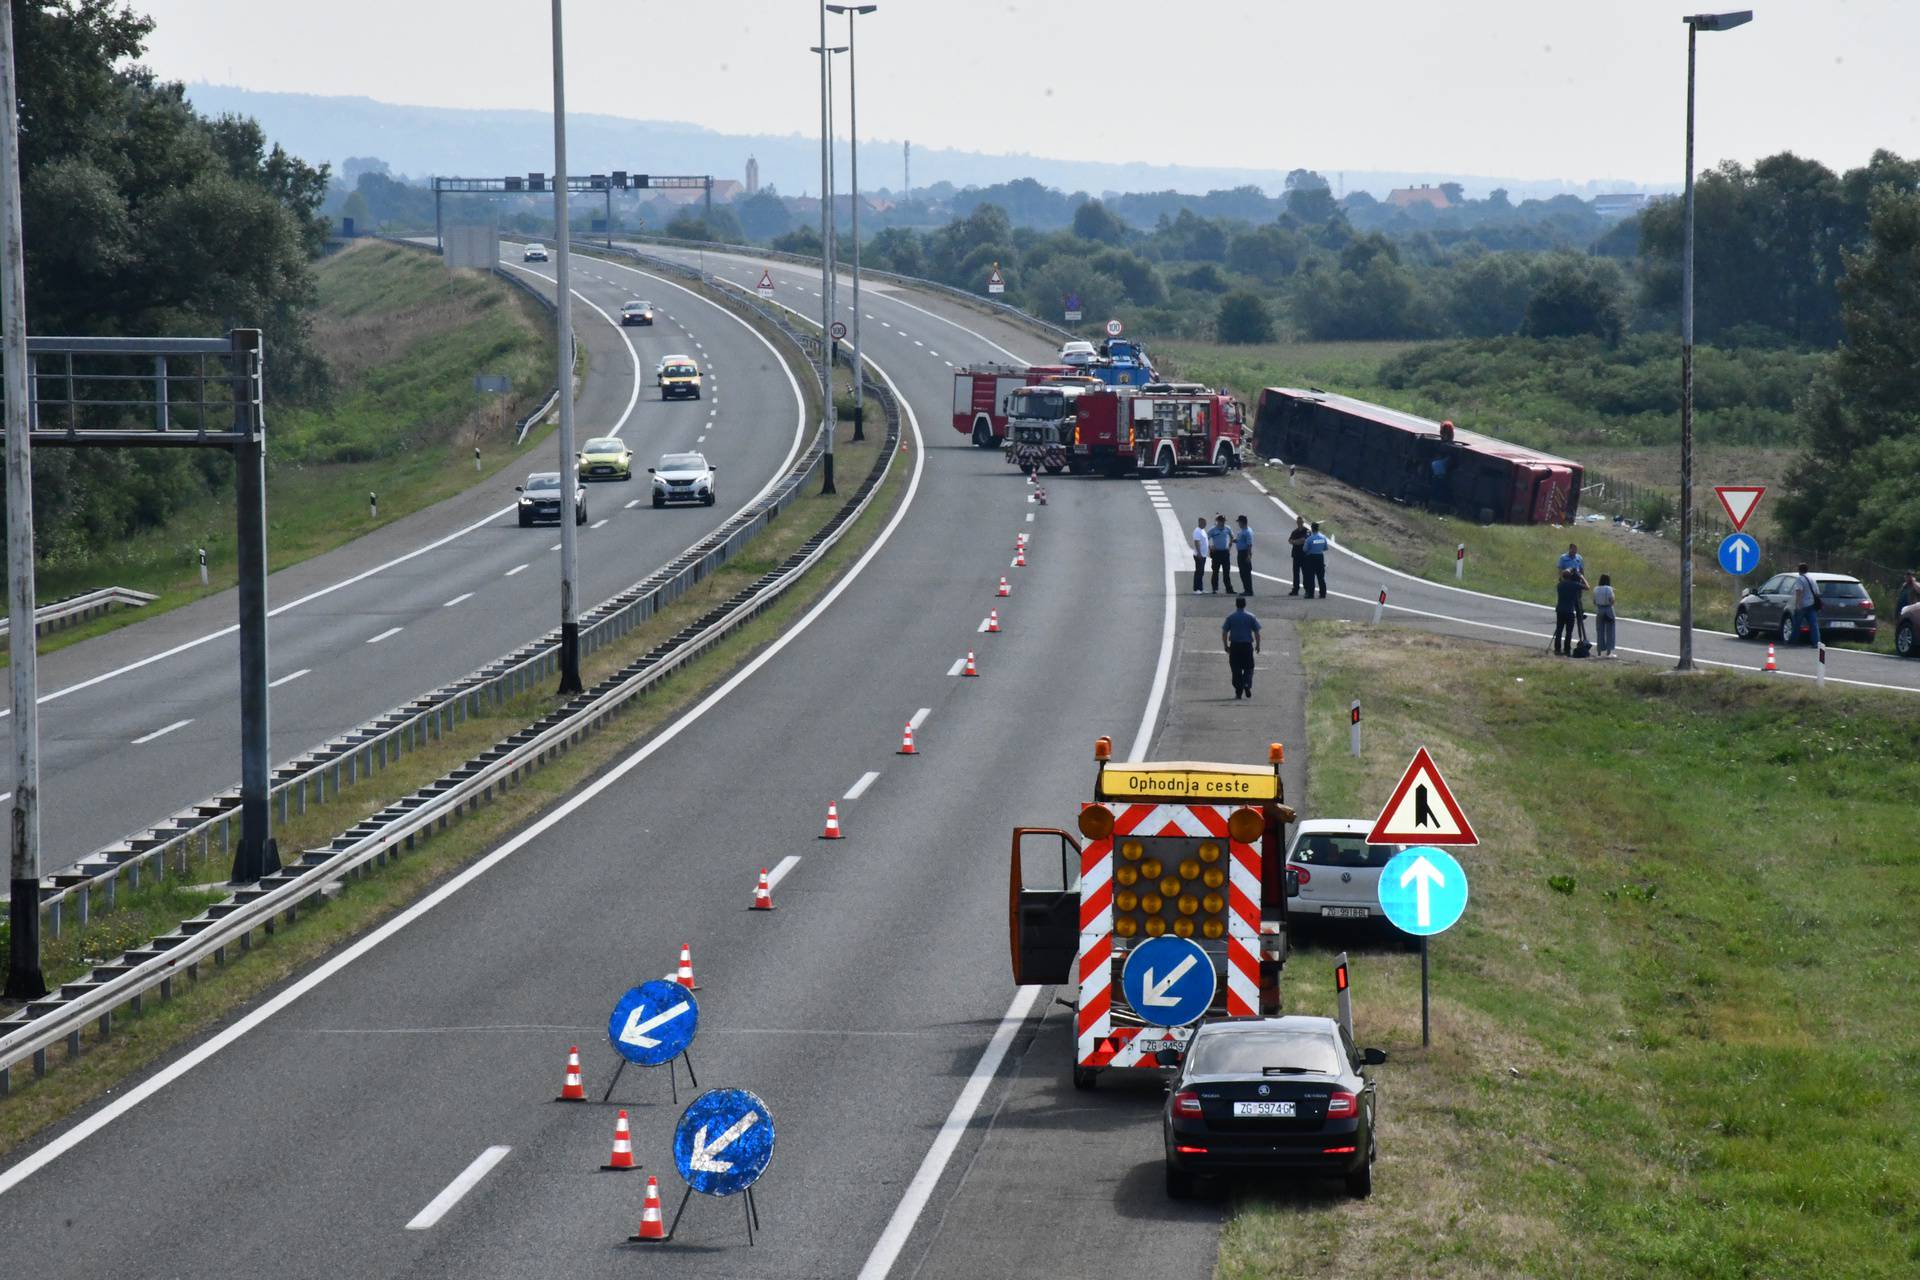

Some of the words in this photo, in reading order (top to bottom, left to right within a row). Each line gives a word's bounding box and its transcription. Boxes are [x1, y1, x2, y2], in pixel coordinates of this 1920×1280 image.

[832, 326, 845, 336] 100
[1109, 323, 1121, 333] 100
[1129, 776, 1199, 794] Ophodnja
[1206, 780, 1249, 793] ceste
[1146, 1040, 1157, 1051] ZG
[1240, 1103, 1253, 1114] ZG
